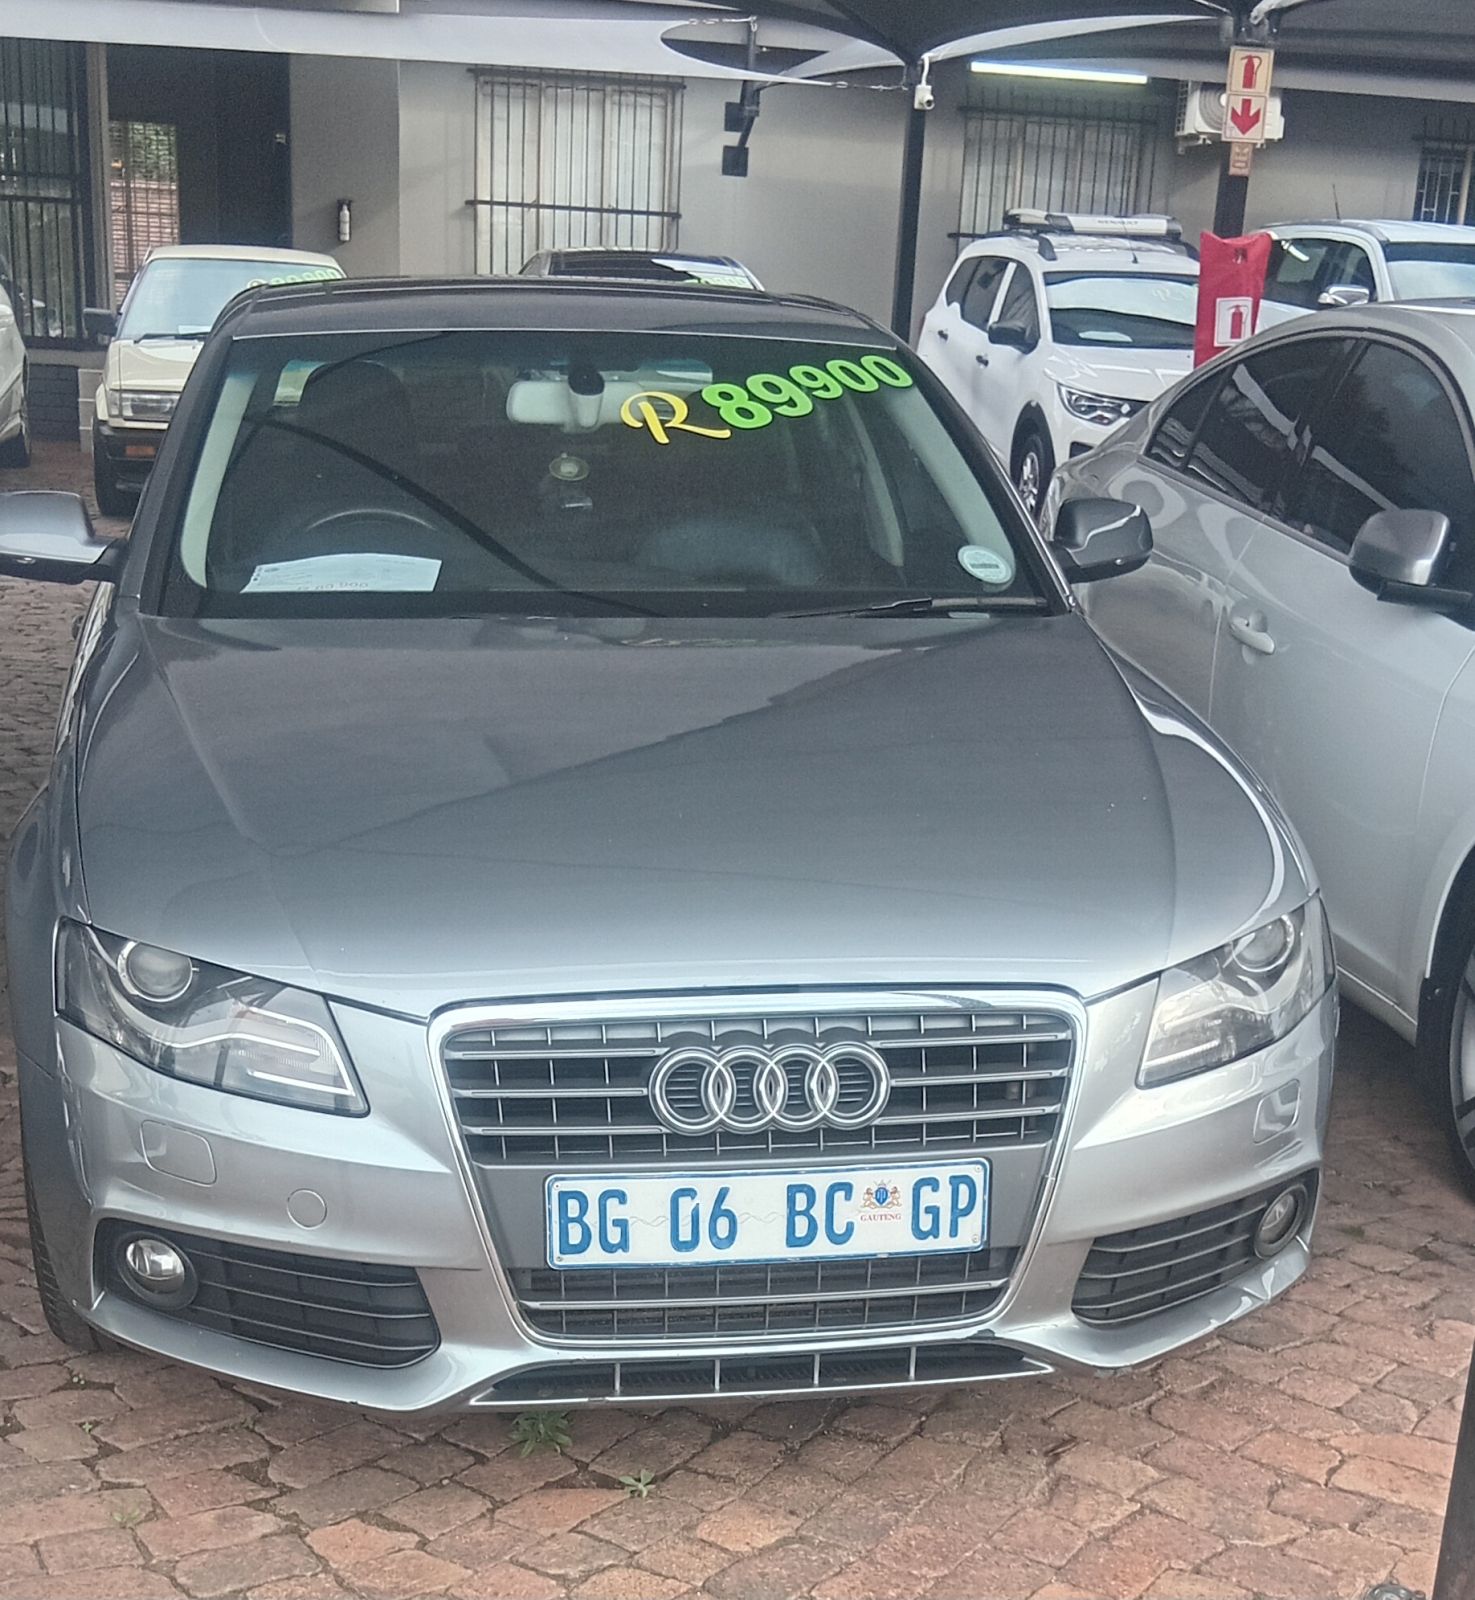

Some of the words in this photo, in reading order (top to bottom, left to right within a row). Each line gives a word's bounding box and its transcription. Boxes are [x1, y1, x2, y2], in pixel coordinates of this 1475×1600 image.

[620, 391, 732, 444] R
[701, 355, 914, 429] 89900
[558, 1188, 629, 1255] BG
[669, 1186, 738, 1252] 06
[786, 1182, 855, 1248] BC
[911, 1174, 977, 1240] GP
[860, 1213, 902, 1222] GAUTENG
